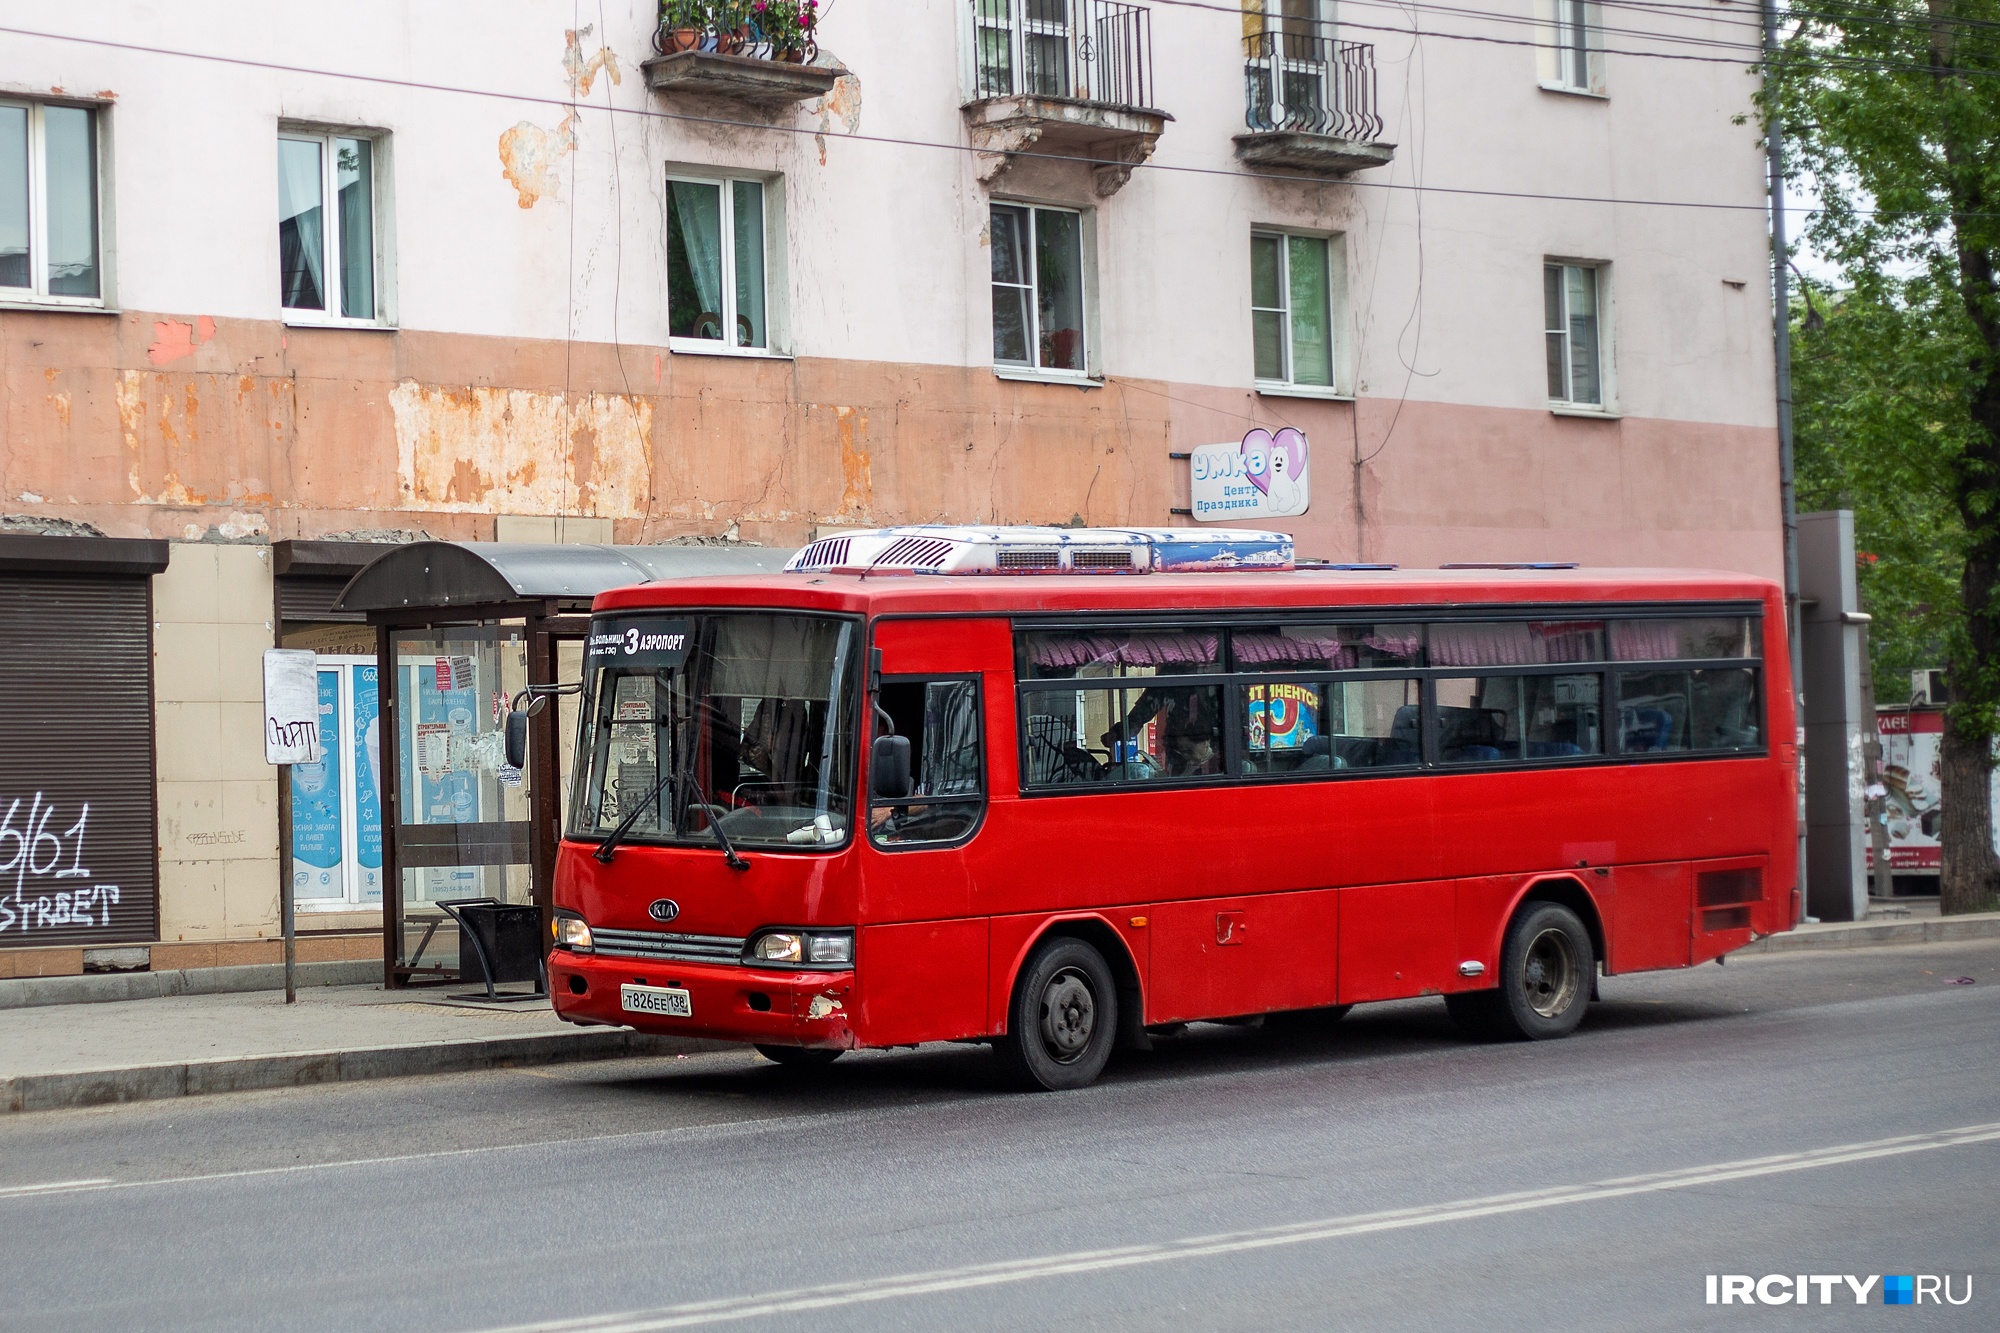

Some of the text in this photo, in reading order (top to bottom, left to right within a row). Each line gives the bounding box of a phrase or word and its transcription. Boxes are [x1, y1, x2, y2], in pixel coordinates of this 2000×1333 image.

[1224, 485, 1258, 497] Центр
[1197, 499, 1258, 513] Праздника
[624, 628, 639, 655] 3
[640, 634, 685, 650] АЭРОПОРТ
[653, 903, 674, 917] KIA
[669, 994, 685, 1008] 138
